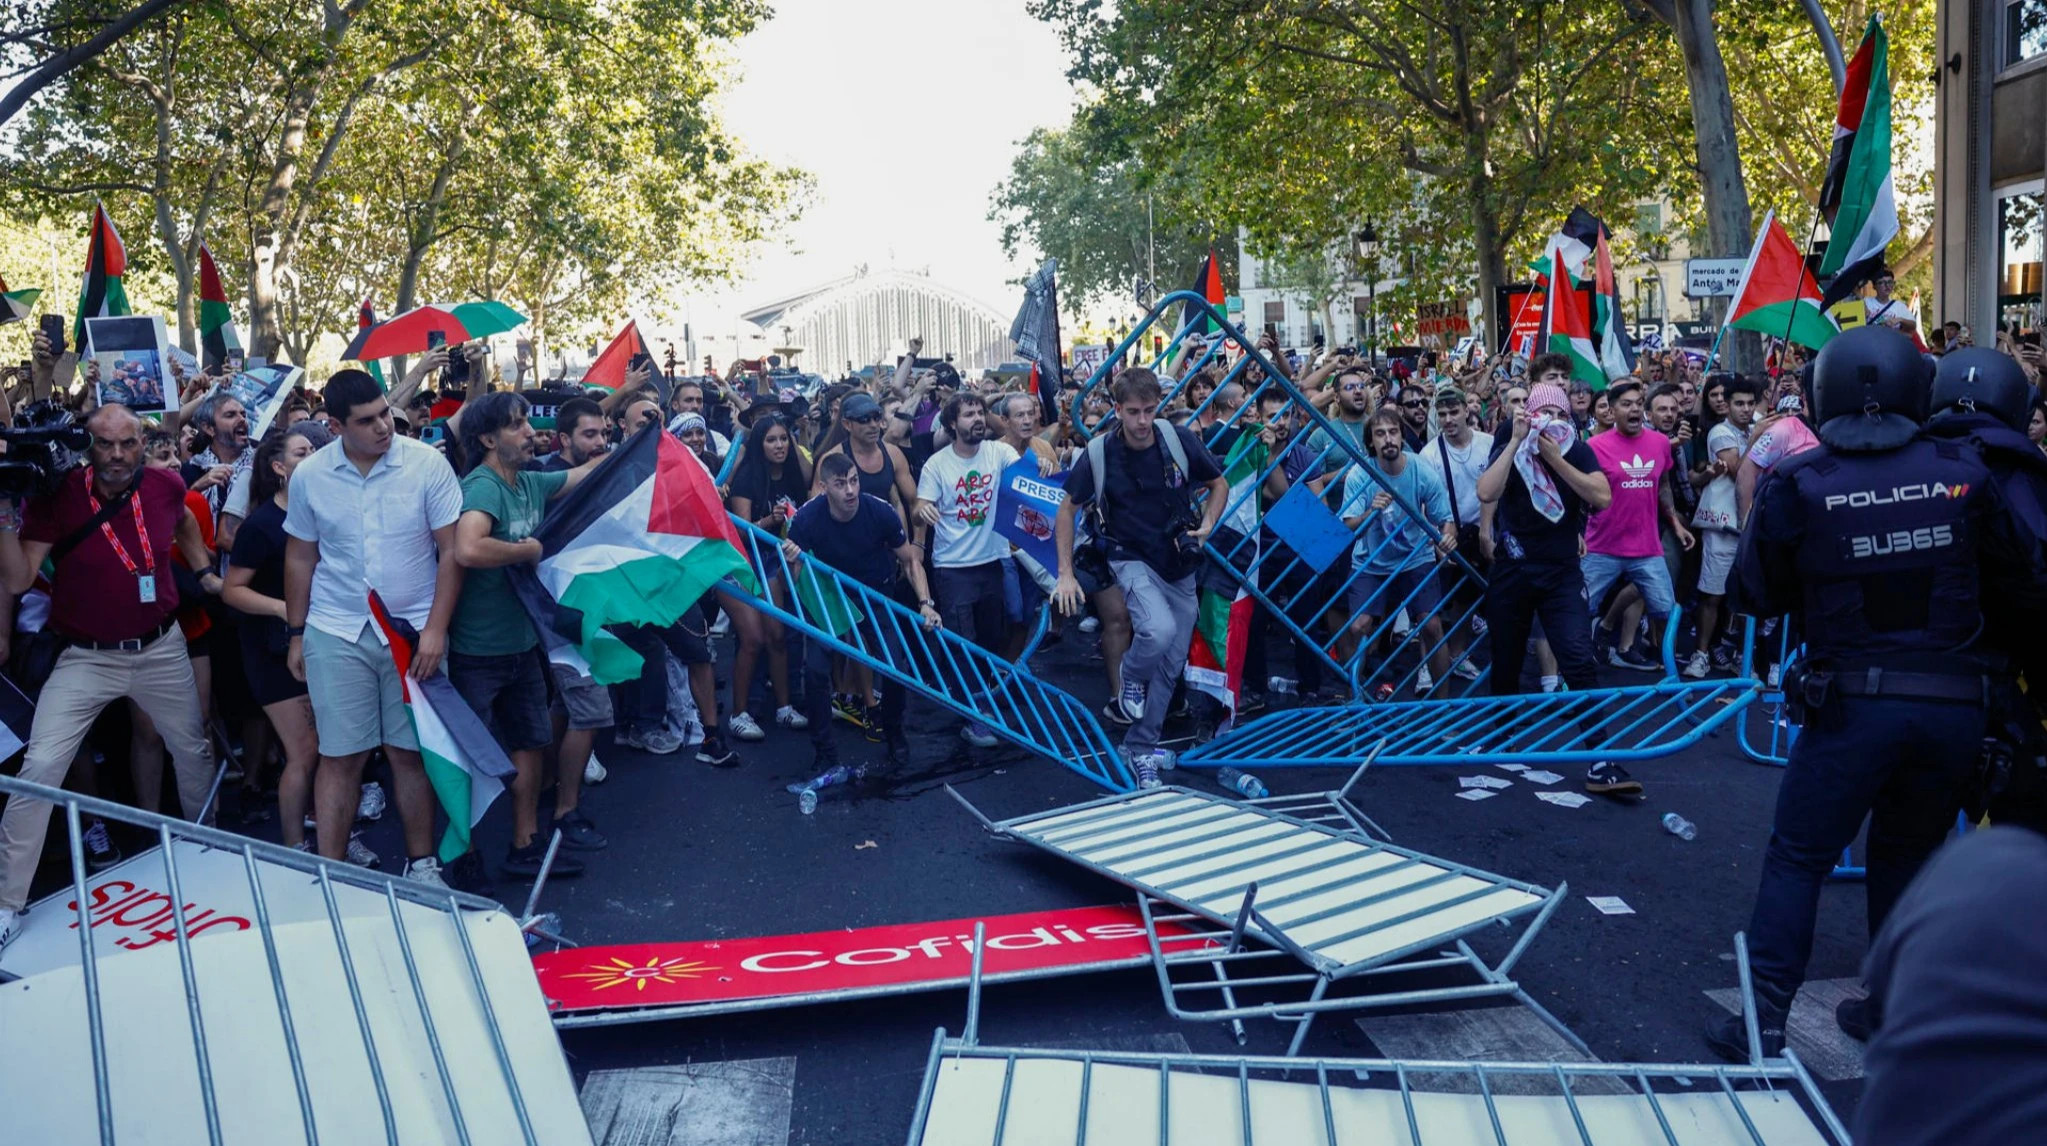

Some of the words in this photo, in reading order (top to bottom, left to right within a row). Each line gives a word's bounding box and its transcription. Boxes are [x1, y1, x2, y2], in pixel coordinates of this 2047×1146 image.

[1692, 267, 1725, 275] mercado
[1729, 267, 1739, 275] de
[1419, 315, 1470, 336] MIERDA
[955, 473, 993, 493] ARO
[1018, 478, 1066, 502] PRESS
[1621, 478, 1654, 489] adidas
[955, 489, 993, 508] ARO
[1825, 482, 1951, 511] POLICIA
[740, 922, 1148, 972] Cofidis
